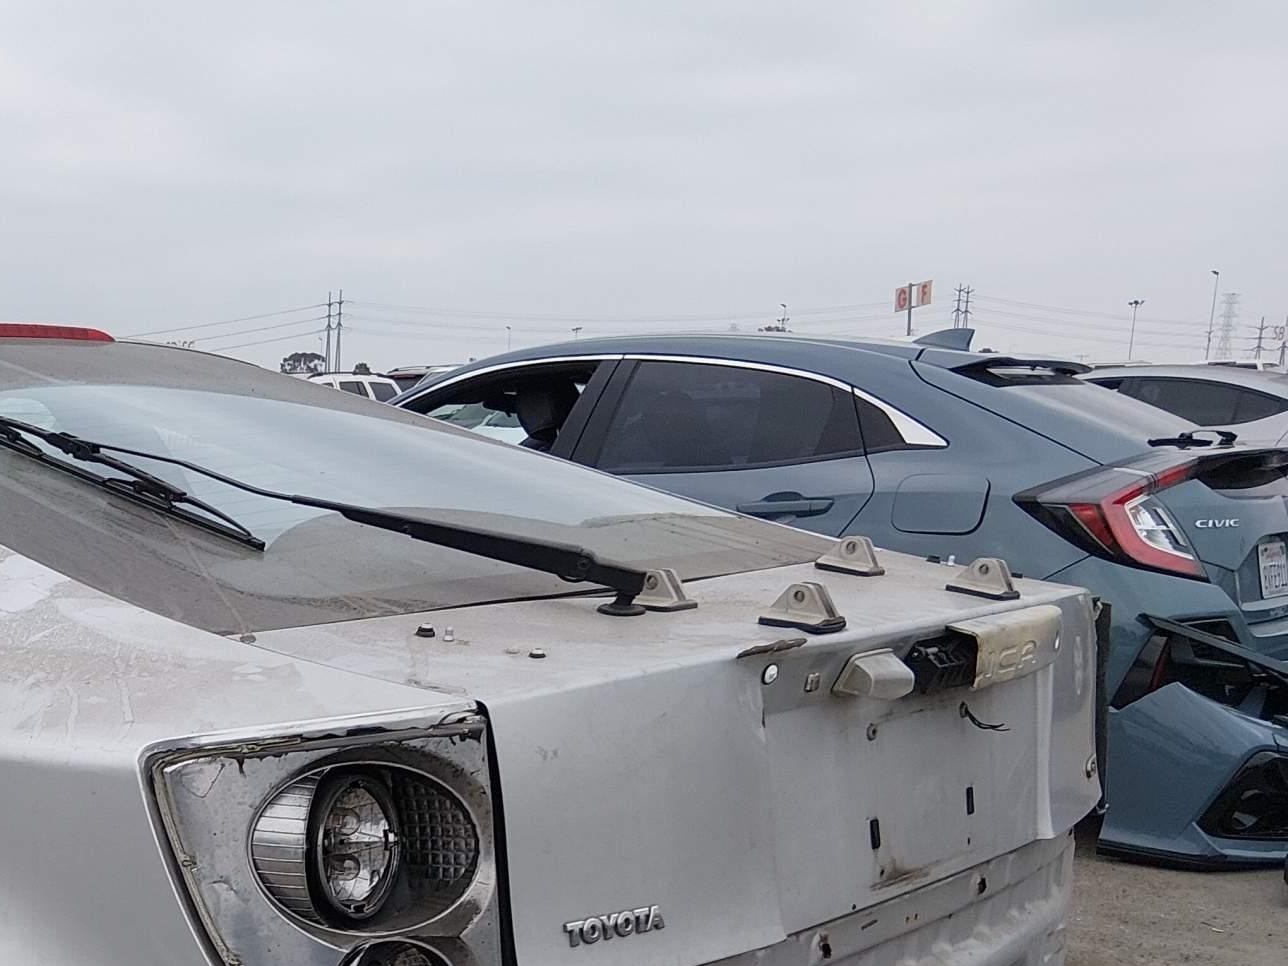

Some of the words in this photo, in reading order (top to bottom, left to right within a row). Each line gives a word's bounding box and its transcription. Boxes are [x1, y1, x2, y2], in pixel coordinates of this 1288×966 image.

[897, 287, 908, 309] G
[920, 283, 929, 305] F
[1195, 518, 1240, 528] CIVIC
[563, 904, 665, 948] TOYOTA
